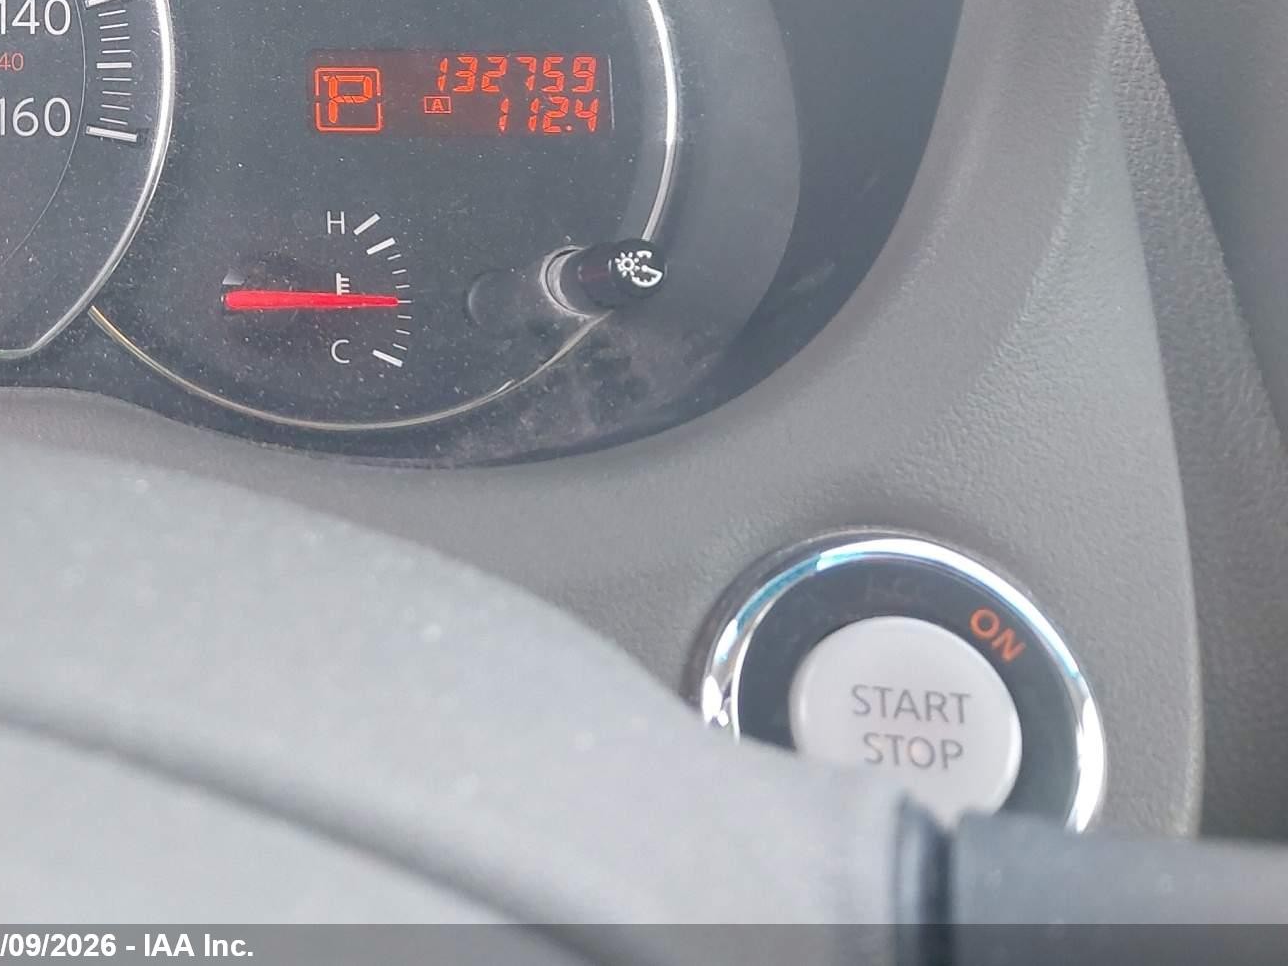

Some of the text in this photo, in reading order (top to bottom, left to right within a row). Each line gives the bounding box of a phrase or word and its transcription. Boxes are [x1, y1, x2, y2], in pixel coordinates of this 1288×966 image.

[436, 55, 598, 93] 132759
[323, 75, 373, 124] P
[498, 96, 599, 133] 112.4
[327, 212, 345, 233] H
[331, 341, 350, 364] C
[969, 608, 1025, 663] ON
[851, 684, 972, 725] START
[863, 732, 964, 771] STOP
